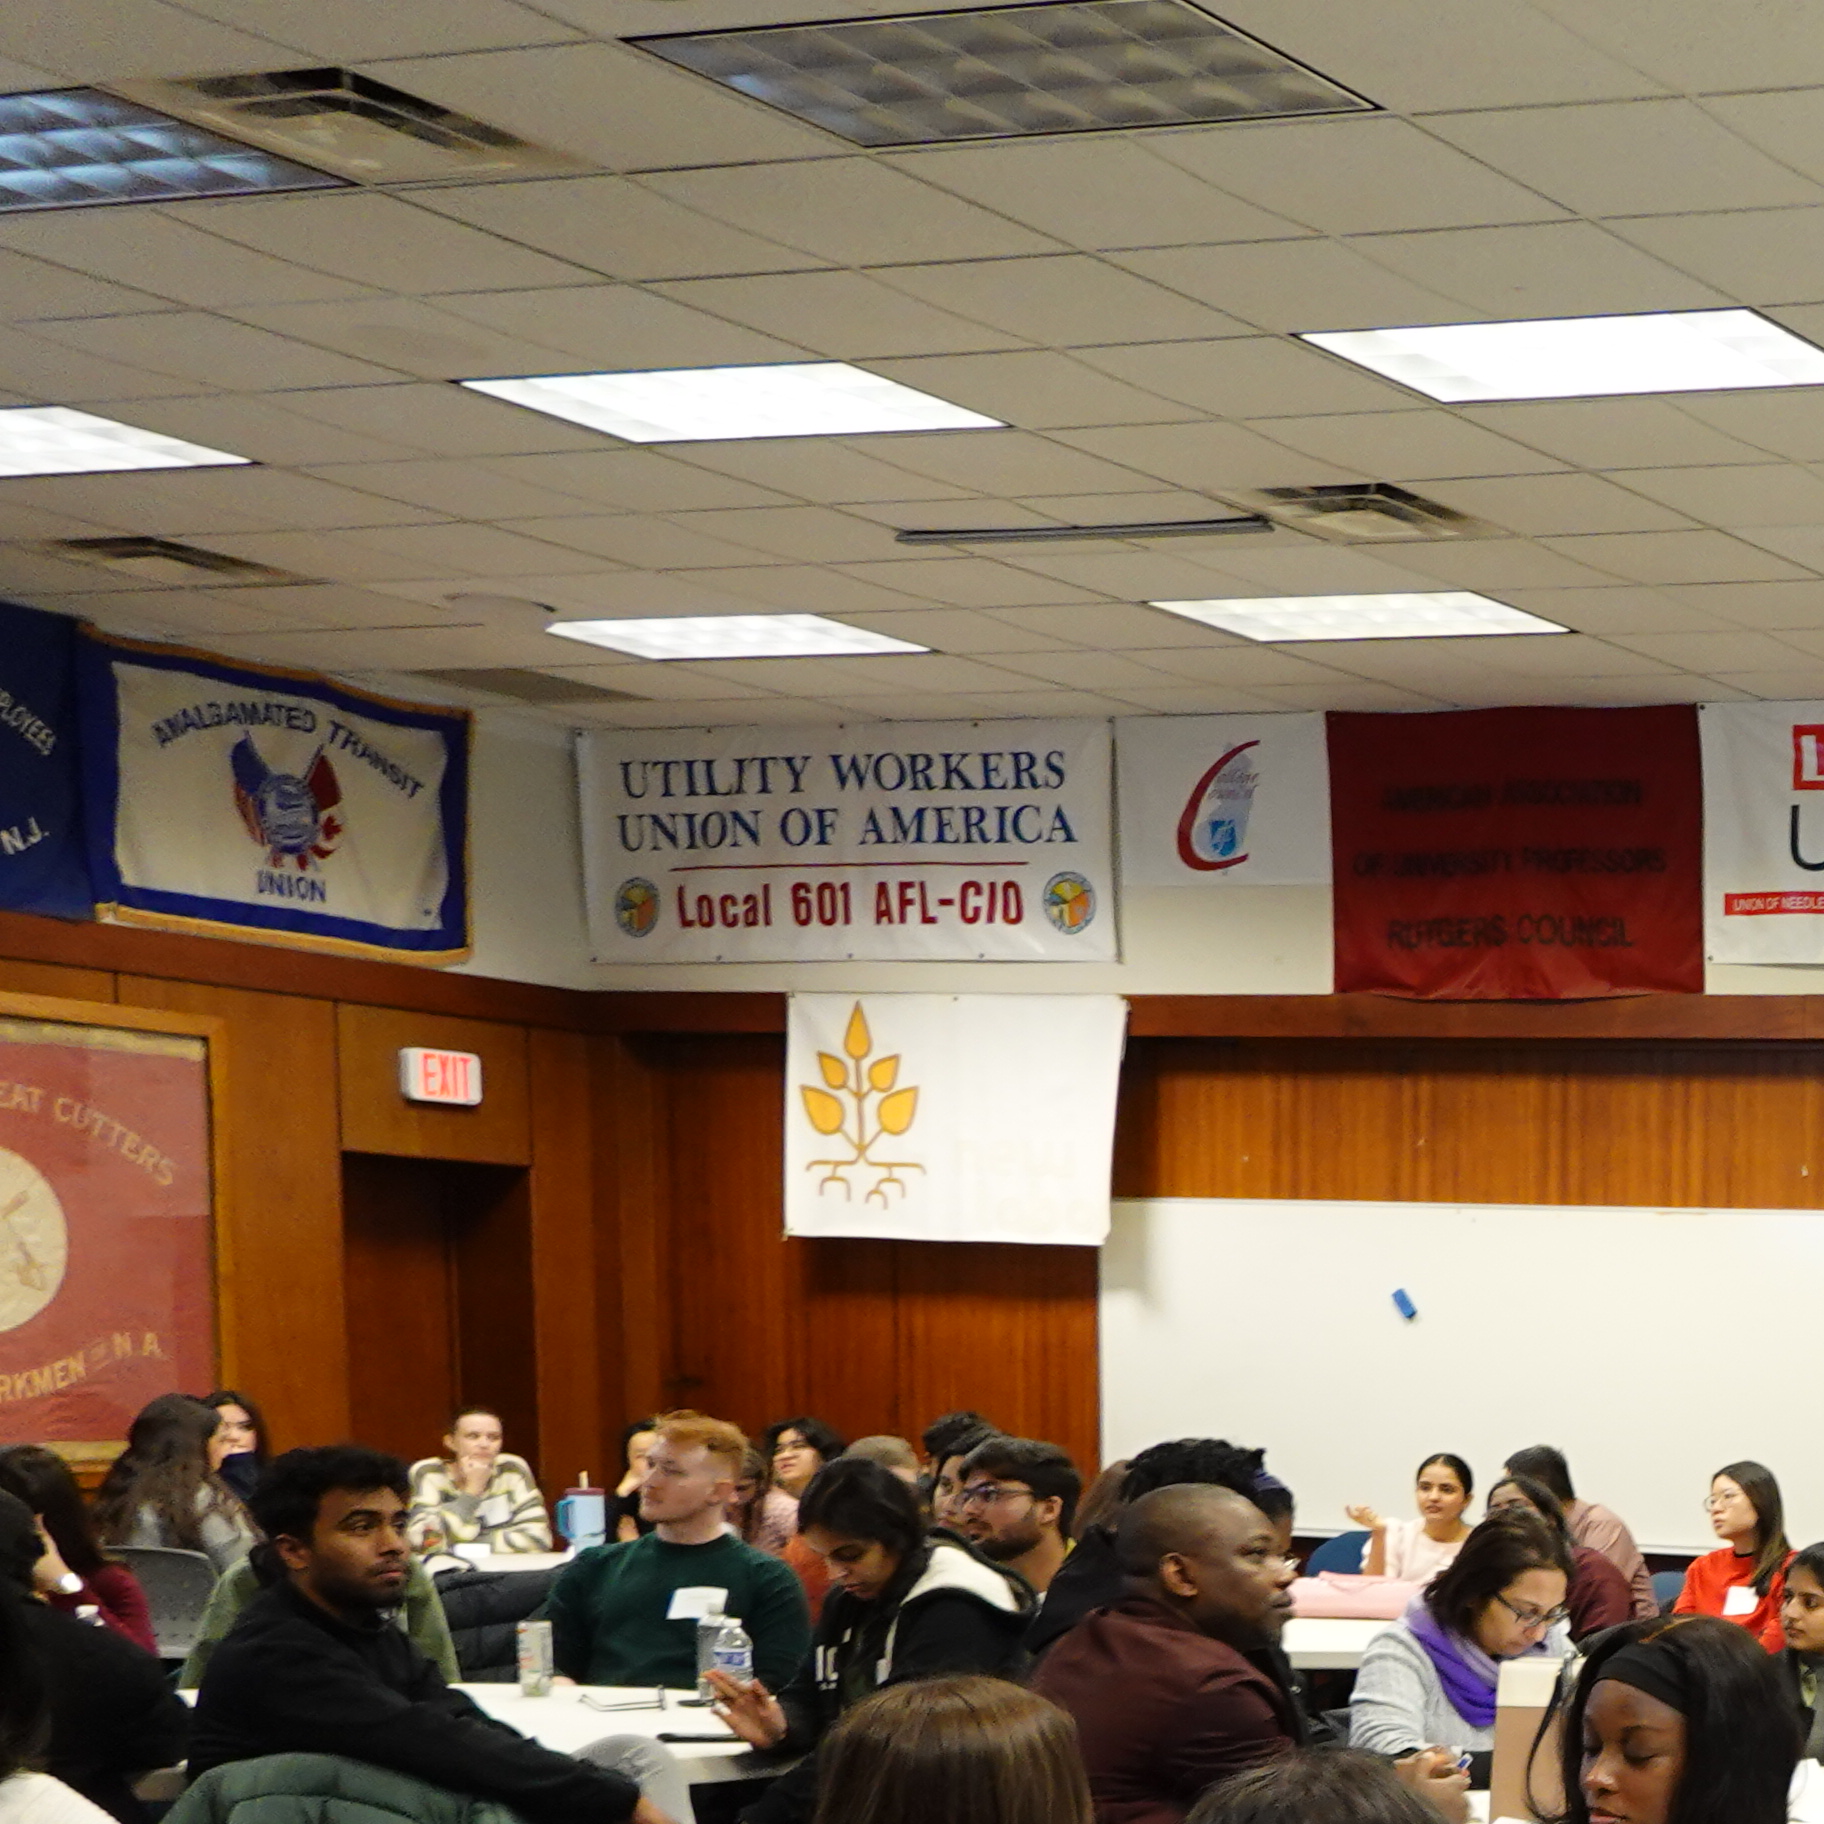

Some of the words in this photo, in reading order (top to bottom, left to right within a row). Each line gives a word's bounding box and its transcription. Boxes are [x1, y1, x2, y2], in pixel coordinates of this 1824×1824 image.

[152, 701, 316, 748] AMALGAMATED
[326, 720, 426, 801] TRANSIT
[619, 755, 811, 799] UTILITY
[830, 751, 1066, 792] WORKERS
[618, 809, 760, 852] UNION
[780, 808, 838, 847] OF
[858, 804, 1078, 845] AMERICA
[256, 869, 327, 902] UNION
[1353, 851, 1385, 877] OF
[677, 882, 770, 929] Local
[791, 881, 851, 926] 601
[874, 879, 1025, 926] AFL-CIO
[1388, 914, 1508, 950] RUTGERS
[1516, 913, 1634, 948] COUNCIL
[423, 1052, 472, 1101] EXIT
[53, 1096, 179, 1188] CUTTERS
